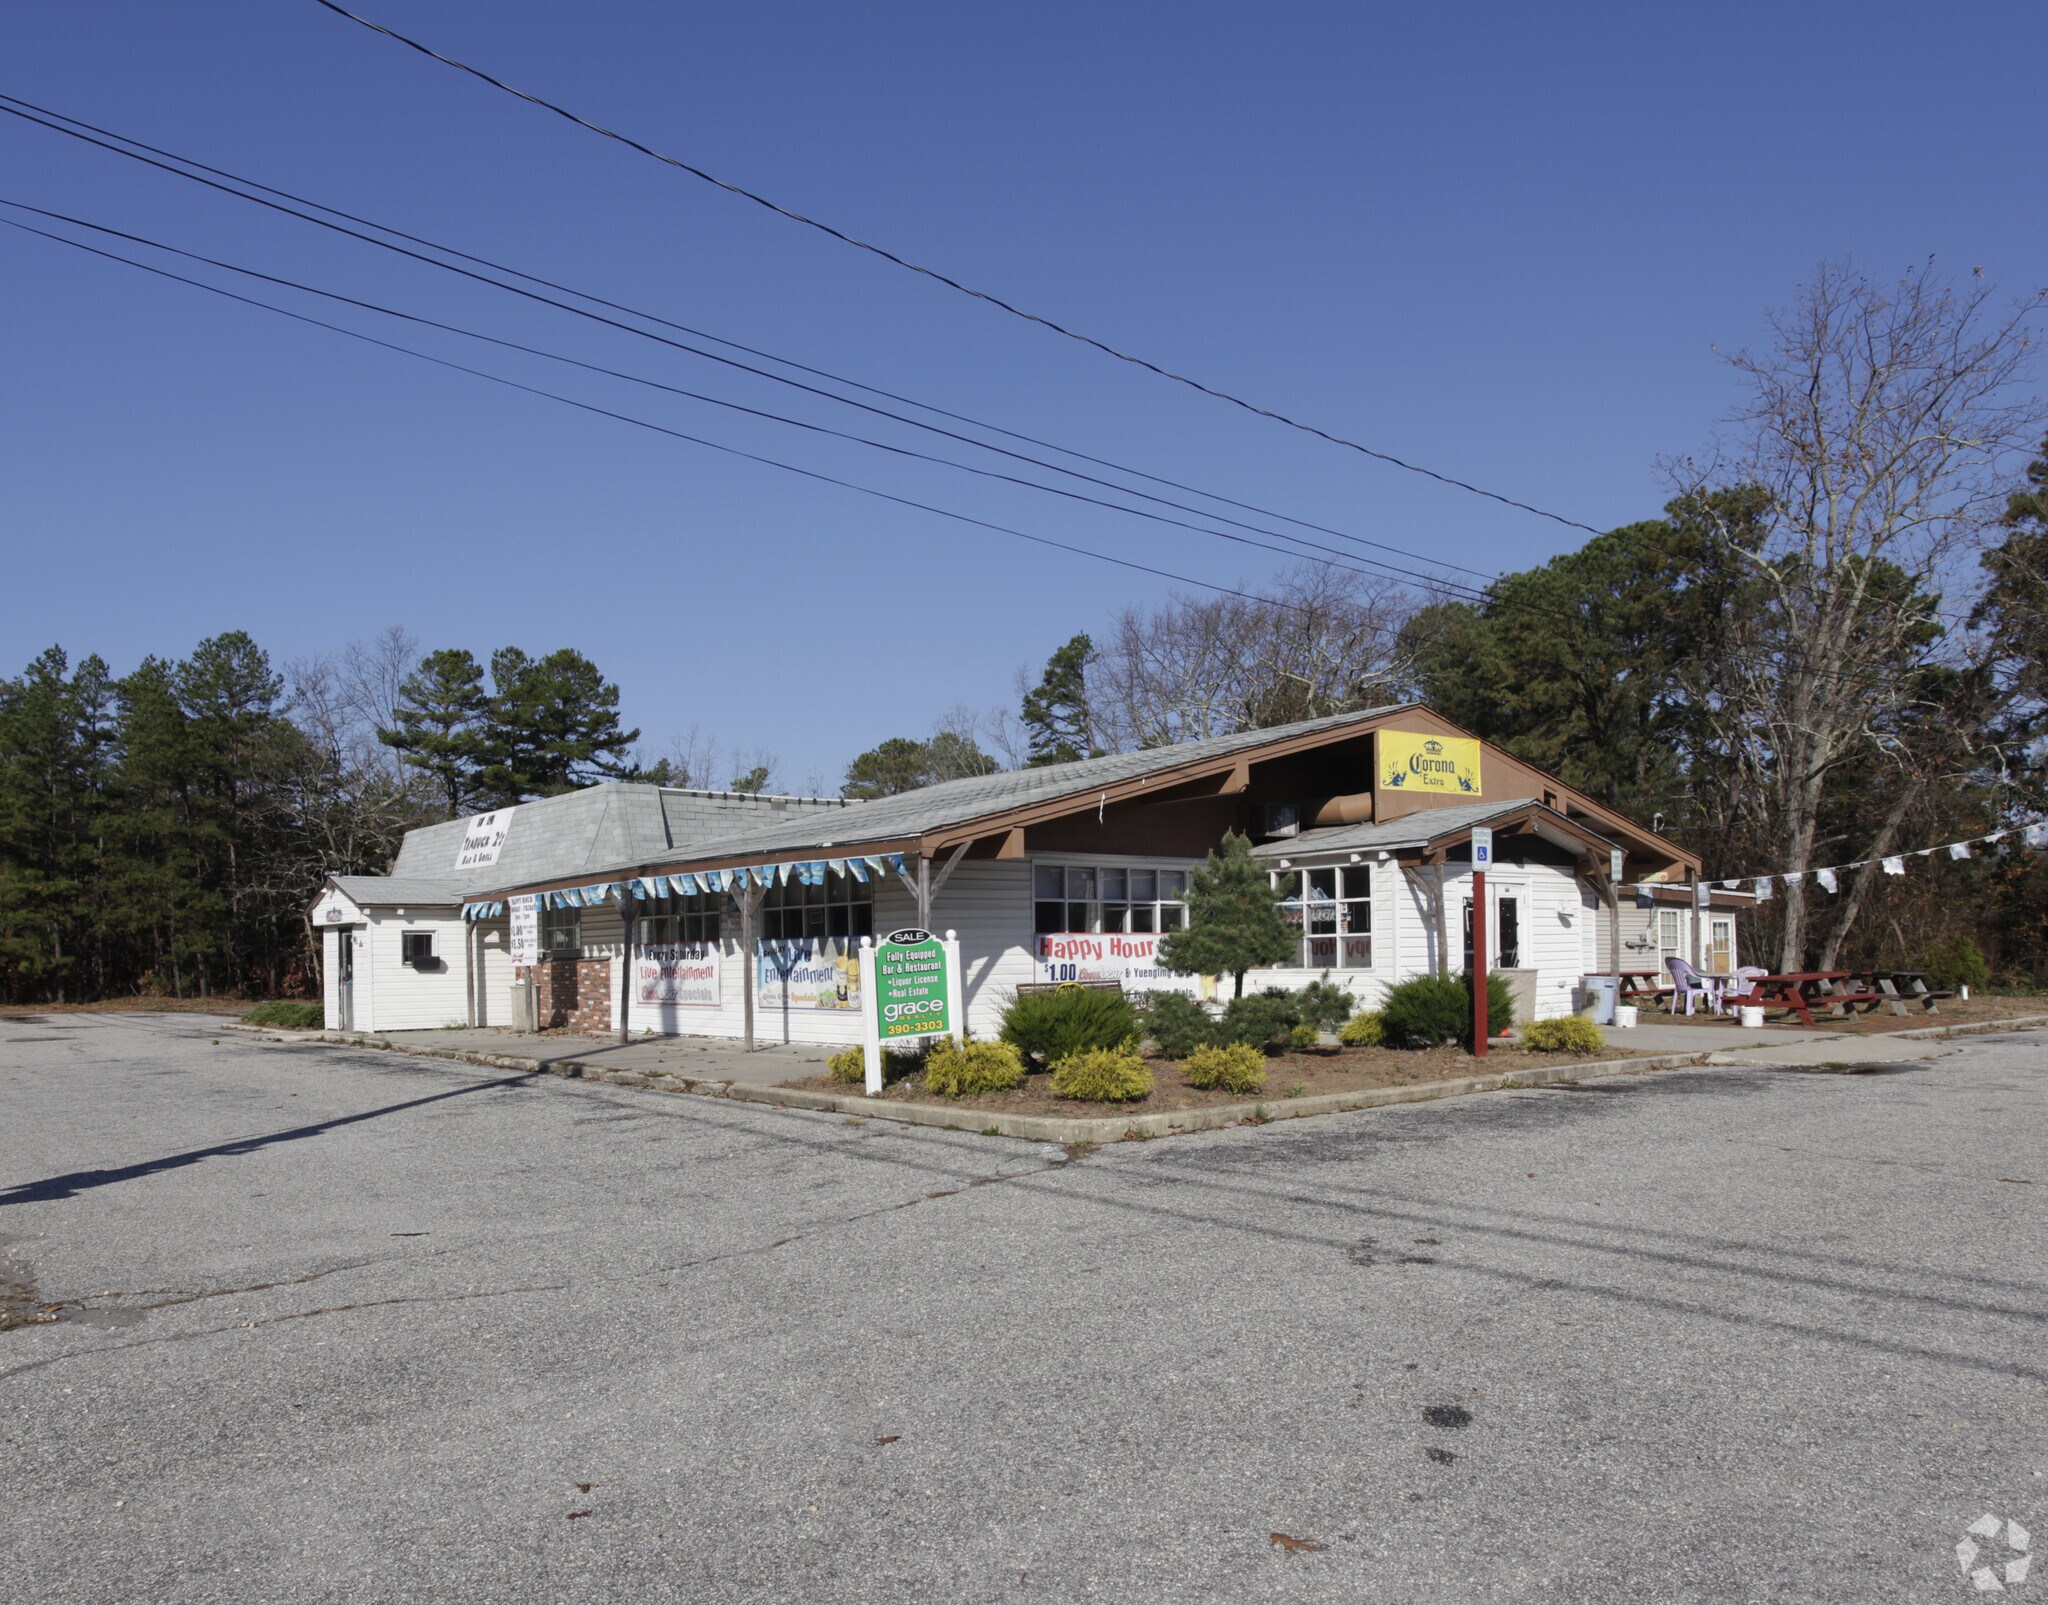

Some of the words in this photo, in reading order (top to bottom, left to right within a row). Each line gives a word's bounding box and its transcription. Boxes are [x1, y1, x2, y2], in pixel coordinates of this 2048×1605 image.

[1409, 752, 1456, 775] Corona
[1423, 774, 1445, 786] Extra
[894, 932, 925, 943] SALE
[649, 950, 669, 961] Every
[670, 948, 705, 961] Saturday
[763, 944, 786, 957] Friday
[787, 947, 812, 963] Live
[886, 951, 903, 963] Fully
[905, 948, 936, 962] Equipped
[1040, 937, 1103, 961] Happy
[1110, 937, 1153, 959] Hour
[640, 966, 657, 980] Live
[661, 965, 713, 981] Entertainment
[765, 967, 833, 984] Entertainment
[882, 964, 894, 976] Bar
[897, 963, 903, 974] &
[905, 961, 941, 973] Restaurant
[1044, 963, 1076, 981] $1.00
[1125, 968, 1131, 978] &
[1133, 968, 1171, 979] Yuengling
[914, 975, 938, 985] License
[679, 987, 713, 1001] Specials
[909, 986, 929, 997] Estate
[884, 999, 944, 1022] grace
[899, 1011, 942, 1021] REALTY
[888, 1020, 943, 1035] 390-3303
